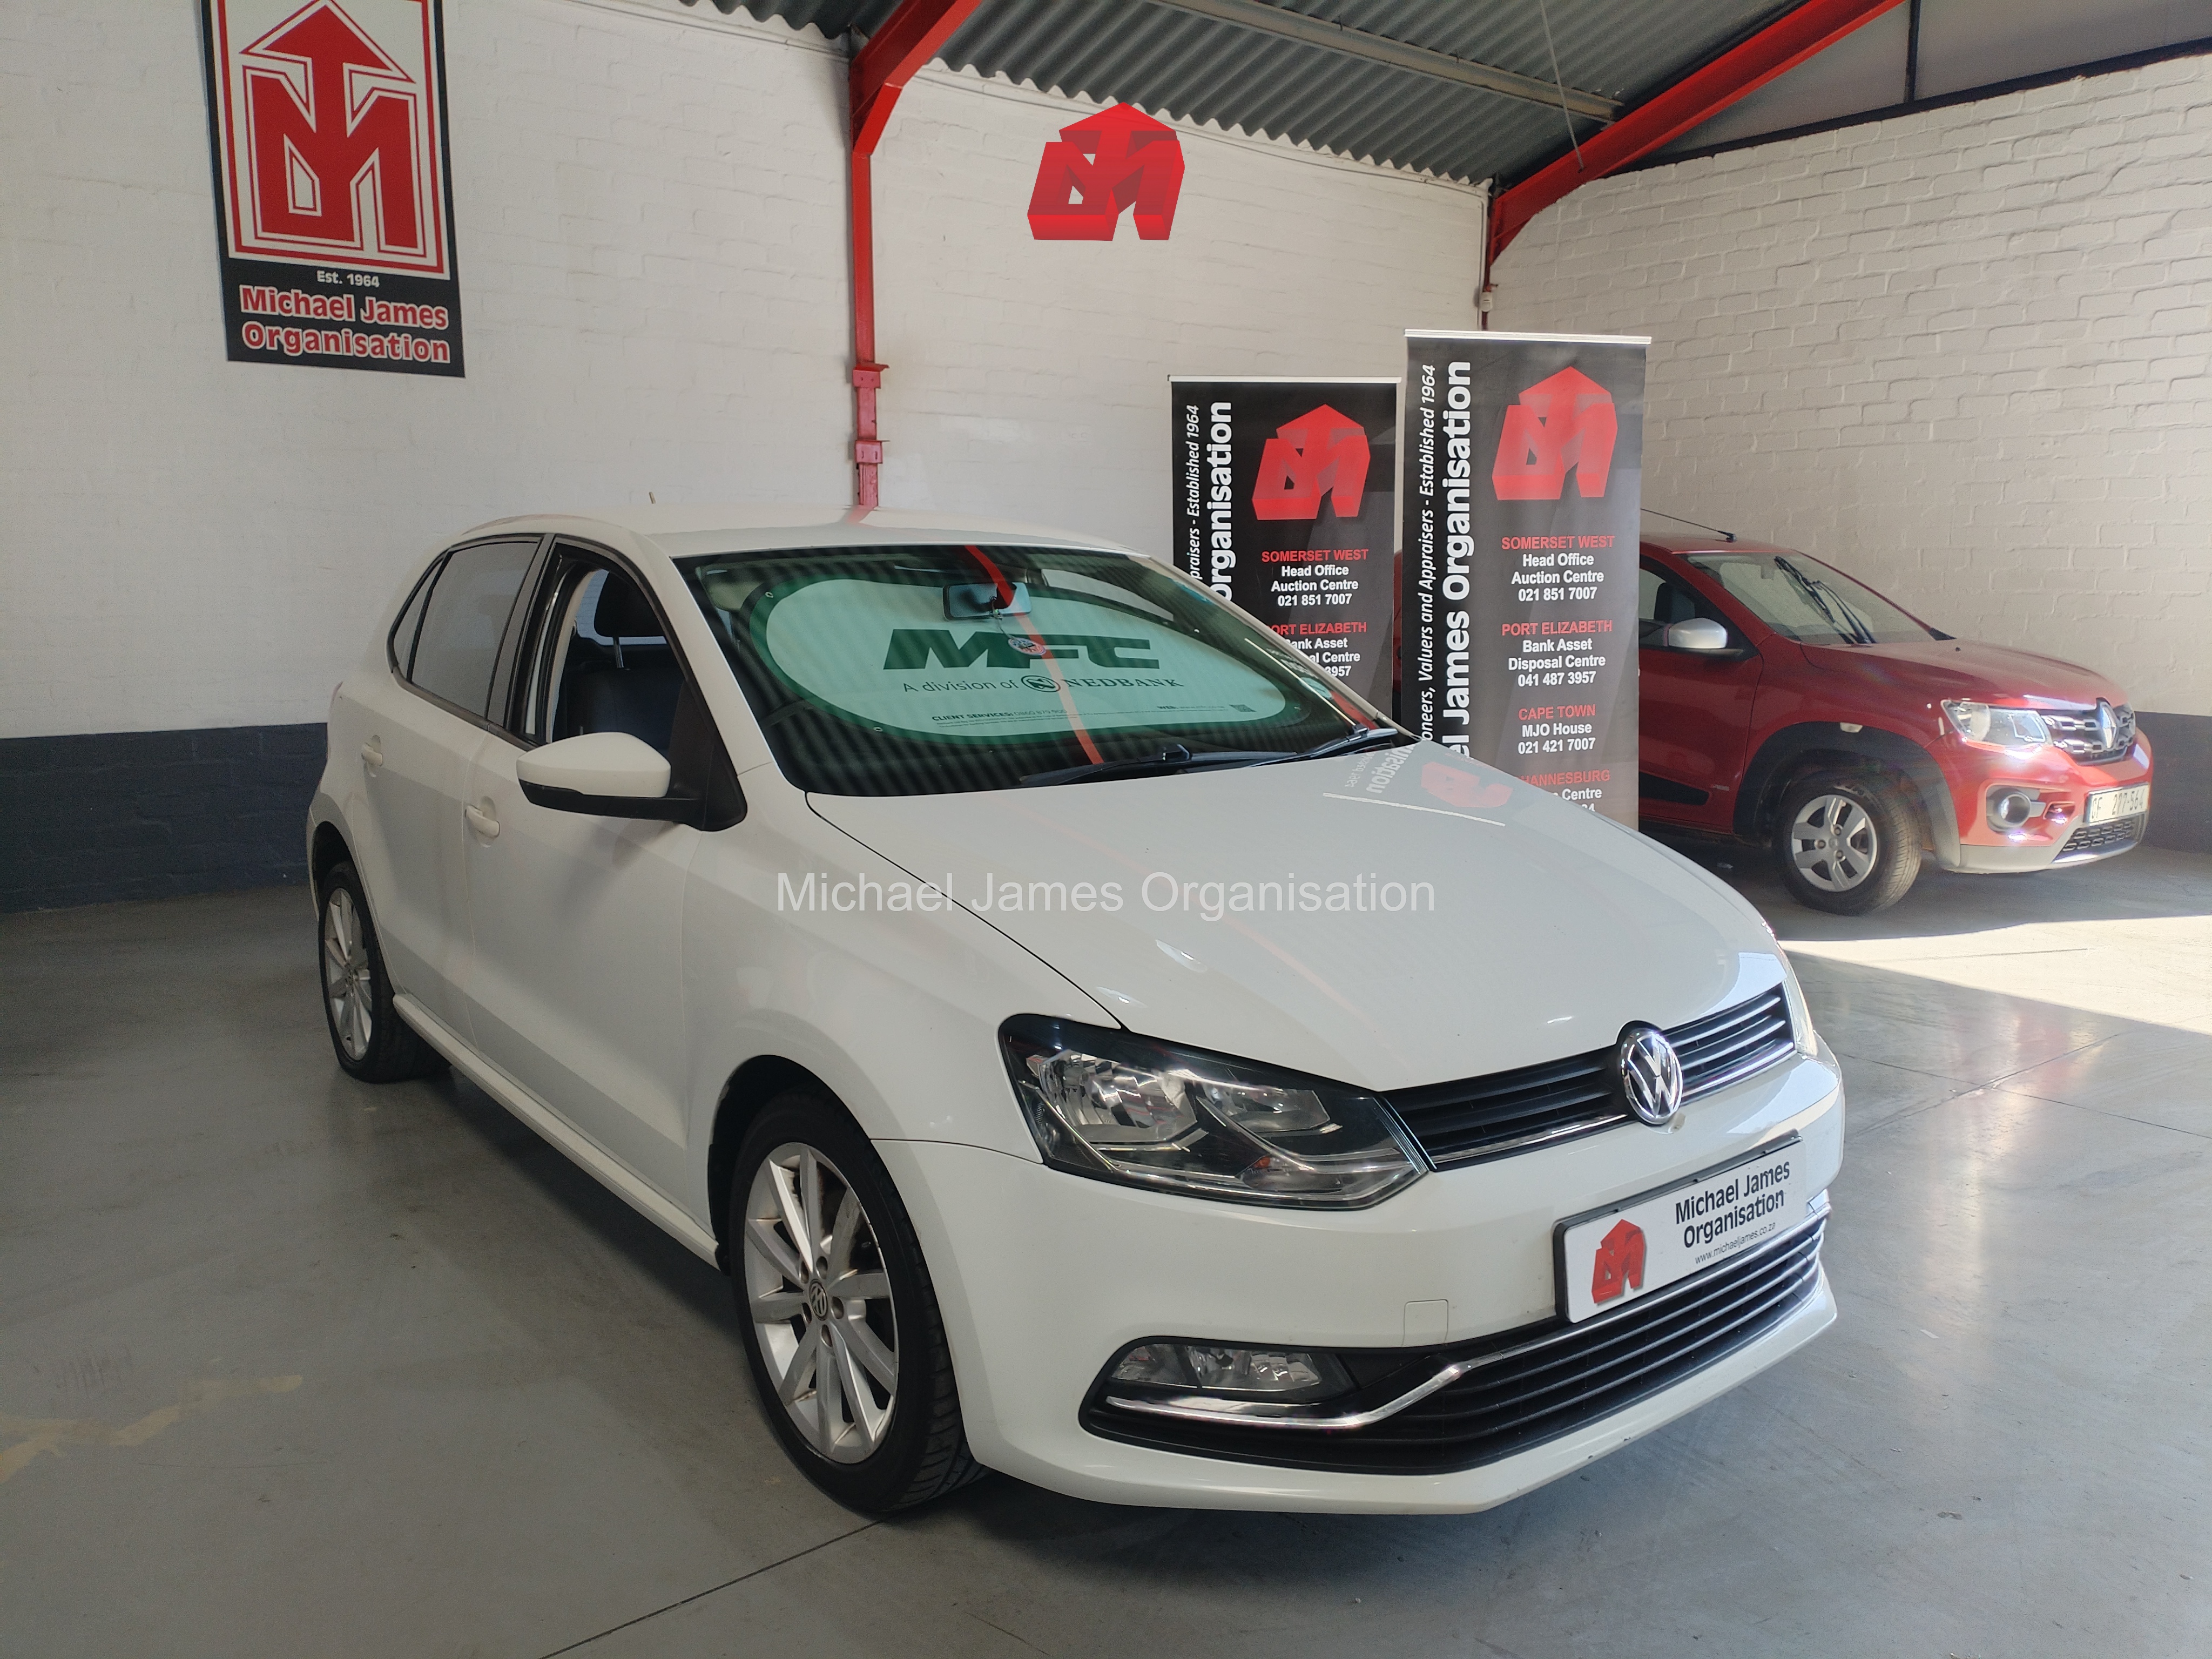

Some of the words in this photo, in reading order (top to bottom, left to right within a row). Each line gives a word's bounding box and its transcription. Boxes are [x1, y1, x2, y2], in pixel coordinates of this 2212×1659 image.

[317, 270, 343, 285] Est.
[347, 273, 379, 287] 1964
[239, 285, 355, 322] Michael
[360, 297, 448, 330] James
[242, 320, 450, 364] Organisation
[1422, 365, 1435, 403] 1964
[1186, 405, 1199, 439] 1964
[1419, 407, 1434, 496] Established
[1185, 441, 1199, 517] Established
[1442, 361, 1474, 601] Organisation
[1418, 509, 1437, 590] Appraisers
[1502, 536, 1574, 549] SOMERSET
[1577, 535, 1615, 548] WEST
[1186, 528, 1203, 579] praisers
[1262, 550, 1330, 563] SOMERSET
[1333, 549, 1368, 561] WEST
[1523, 554, 1554, 566] Head
[1557, 553, 1594, 565] Office
[1282, 566, 1312, 577] Head
[1314, 565, 1349, 576] Office
[1512, 571, 1560, 584] Auction
[1563, 570, 1604, 583] Centre
[1271, 581, 1317, 592] Auction
[1320, 580, 1359, 590] Centre
[1518, 589, 1539, 602] 021
[1543, 588, 1564, 600] 851
[1569, 586, 1597, 599] 7007
[1278, 595, 1297, 606] 021
[1301, 594, 1321, 605] 851
[1326, 594, 1352, 605] 7007
[1418, 592, 1433, 623] and
[1267, 624, 1297, 636] ORT
[1300, 622, 1367, 635] ELIZABETH
[1502, 623, 1538, 636] PORT
[1541, 620, 1613, 635] ELIZABETH
[883, 629, 1159, 670] MFC
[1314, 637, 1348, 649] Asset
[1523, 639, 1554, 653] Bank
[1557, 638, 1592, 651] Asset
[1323, 652, 1360, 663] Centre
[1418, 626, 1433, 682] Valuers
[1443, 611, 1469, 725] James
[1508, 656, 1562, 672] Disposal
[1566, 655, 1606, 667] Centre
[903, 683, 918, 692] A
[922, 681, 997, 691] division
[1000, 679, 1019, 689] of
[1061, 679, 1184, 687] NEDBANK
[1518, 674, 1539, 687] 041
[1542, 673, 1564, 686] 487
[1567, 671, 1596, 684] 3957
[1422, 687, 1435, 740] oneers,
[1519, 707, 1553, 720] CAPE
[1557, 704, 1596, 719] TOWN
[1522, 724, 1550, 737] MJO
[1553, 723, 1592, 735] House
[1518, 741, 1539, 754] 021
[1542, 740, 1563, 753] 421
[1567, 738, 1596, 751] 7007
[1517, 770, 1610, 786] HANNESBURG
[1562, 788, 1602, 800] Centre
[1675, 1178, 1738, 1224] Michael
[1744, 1162, 1790, 1197] James
[1684, 1190, 1784, 1248] Organisation
[1695, 1222, 1776, 1264] www.michaeljames.co.za
